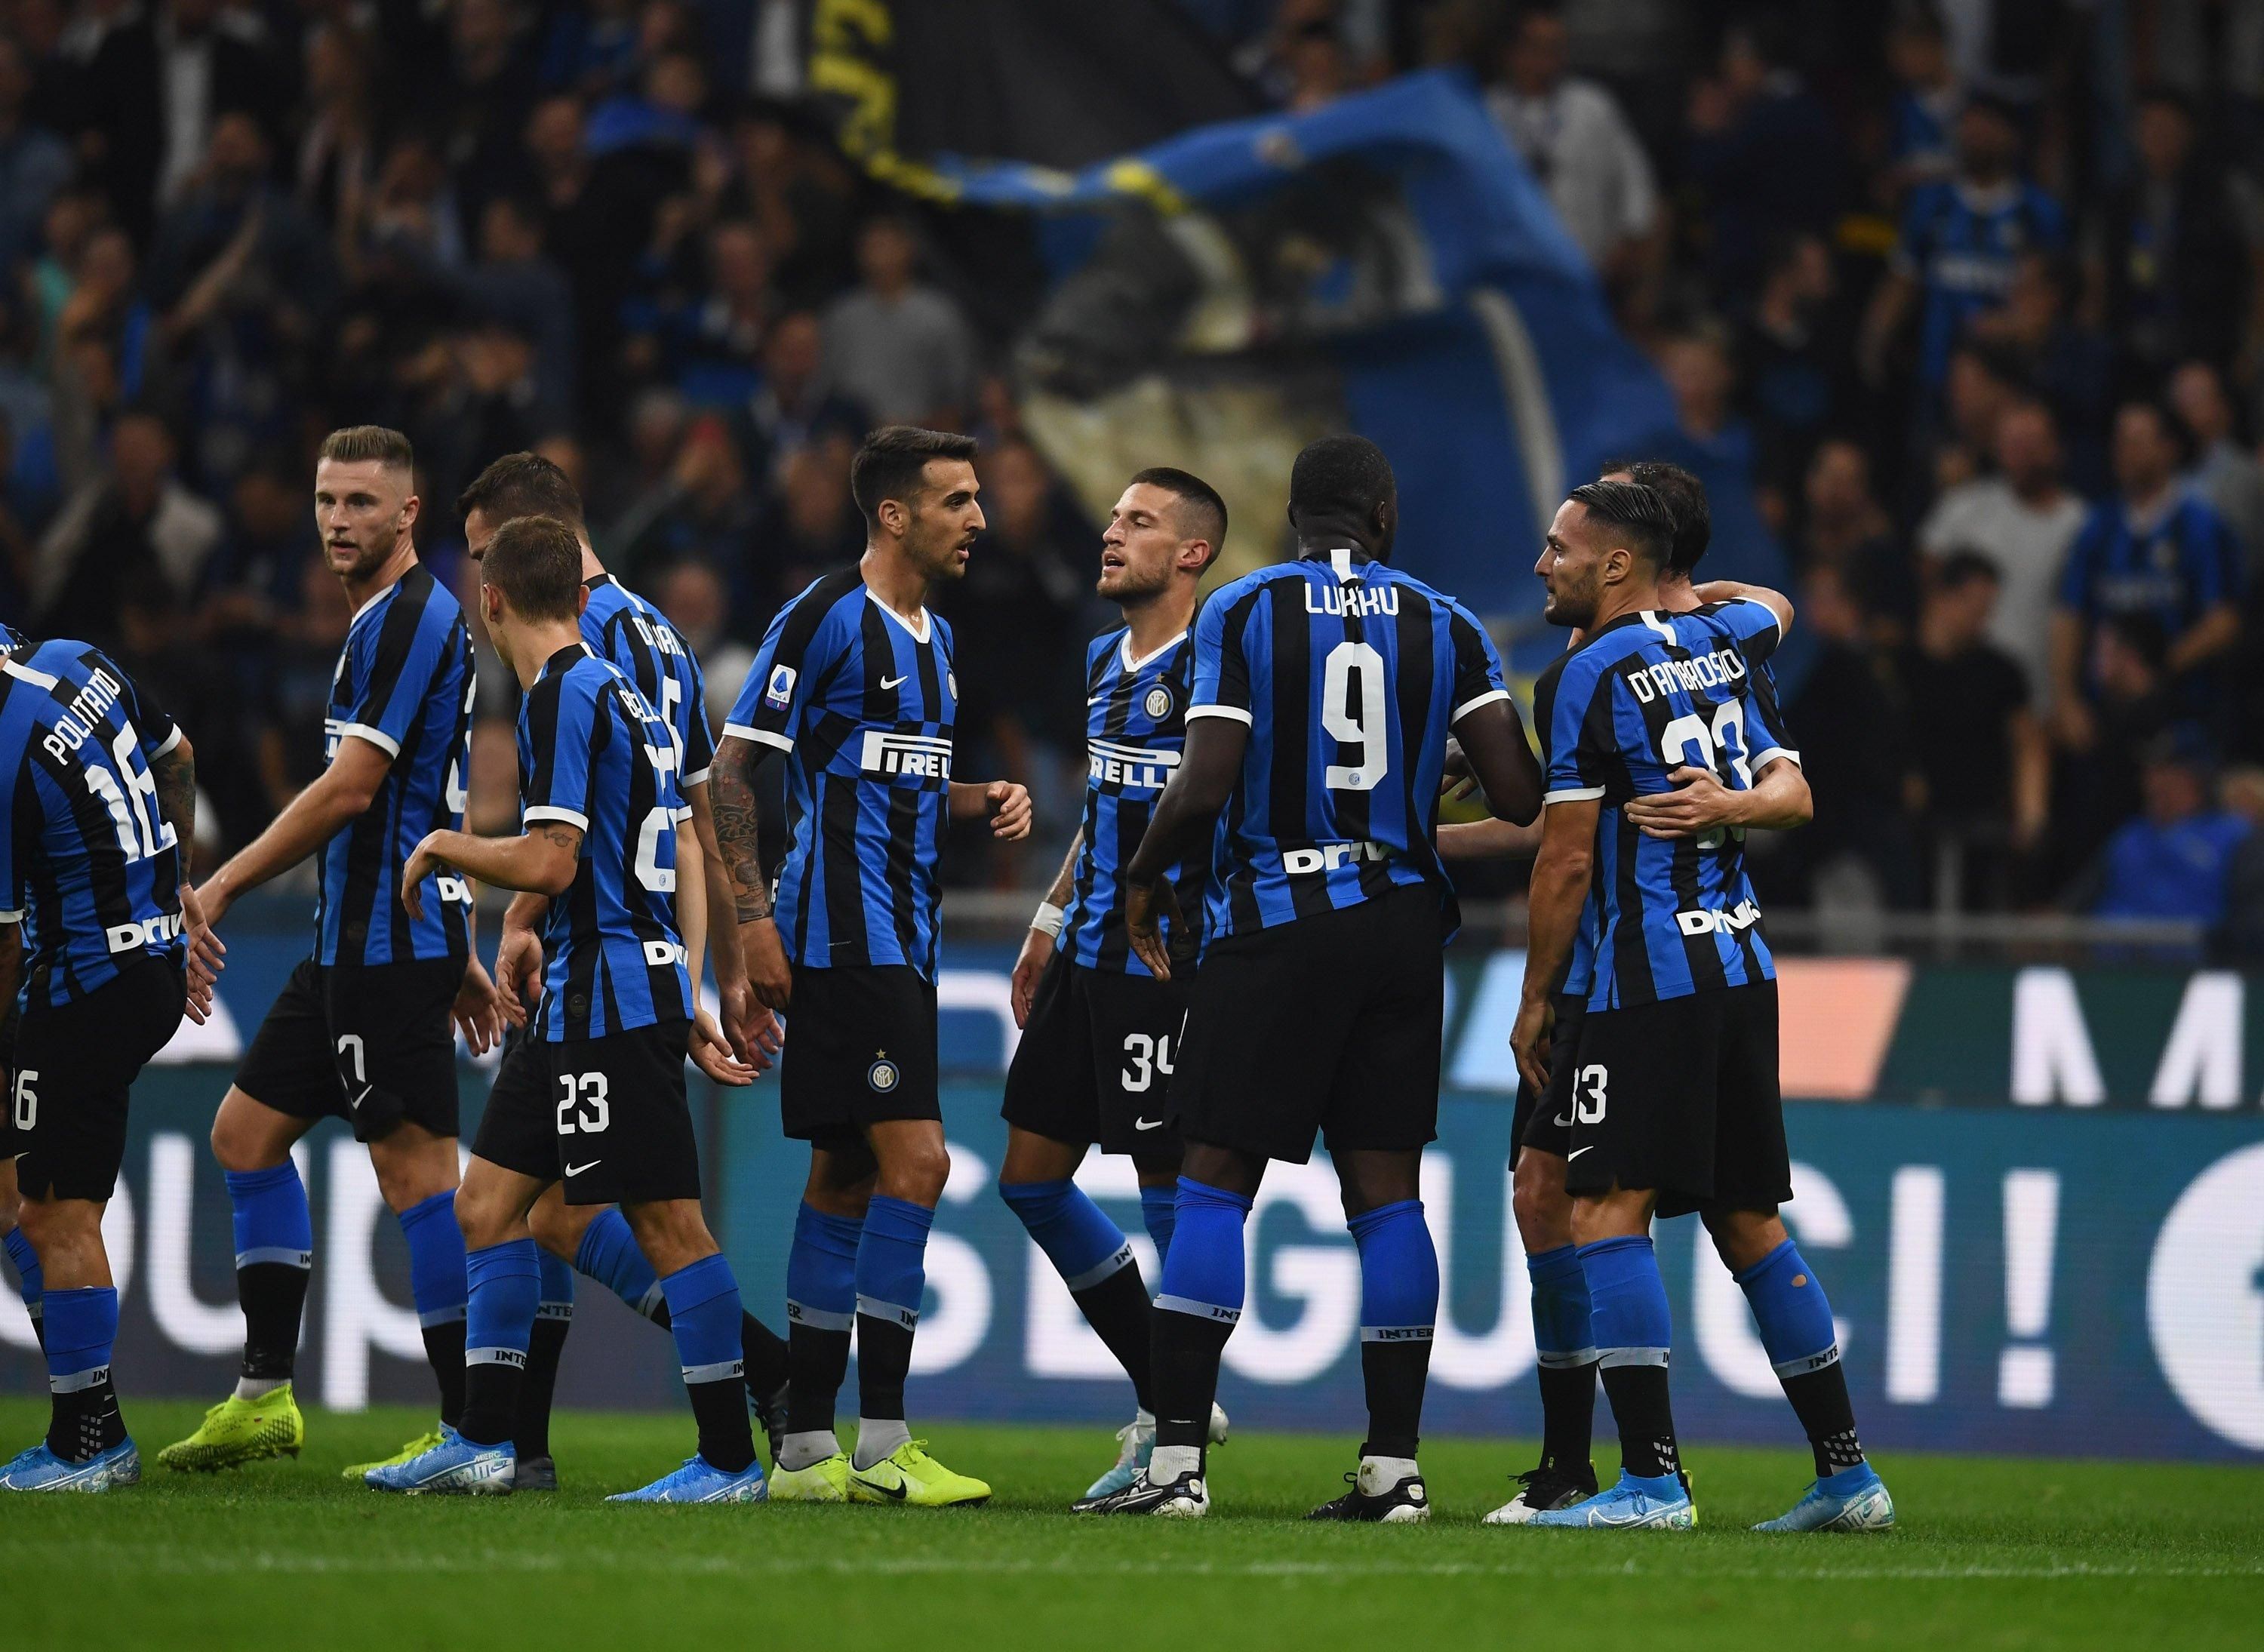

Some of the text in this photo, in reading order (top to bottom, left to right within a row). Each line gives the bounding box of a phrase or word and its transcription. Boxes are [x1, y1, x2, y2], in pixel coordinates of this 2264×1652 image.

[1305, 583, 1398, 617] LUKKU
[1627, 648, 1746, 703] D'AMBROSIO
[43, 667, 121, 766] POLITANO
[1322, 641, 1388, 790] 9
[861, 731, 952, 779] PIREL
[84, 720, 178, 864] 16
[332, 1034, 366, 1091] 7
[11, 1067, 38, 1131] 6
[557, 1072, 609, 1134] 23
[851, 1142, 2059, 1409] SEGUCI!
